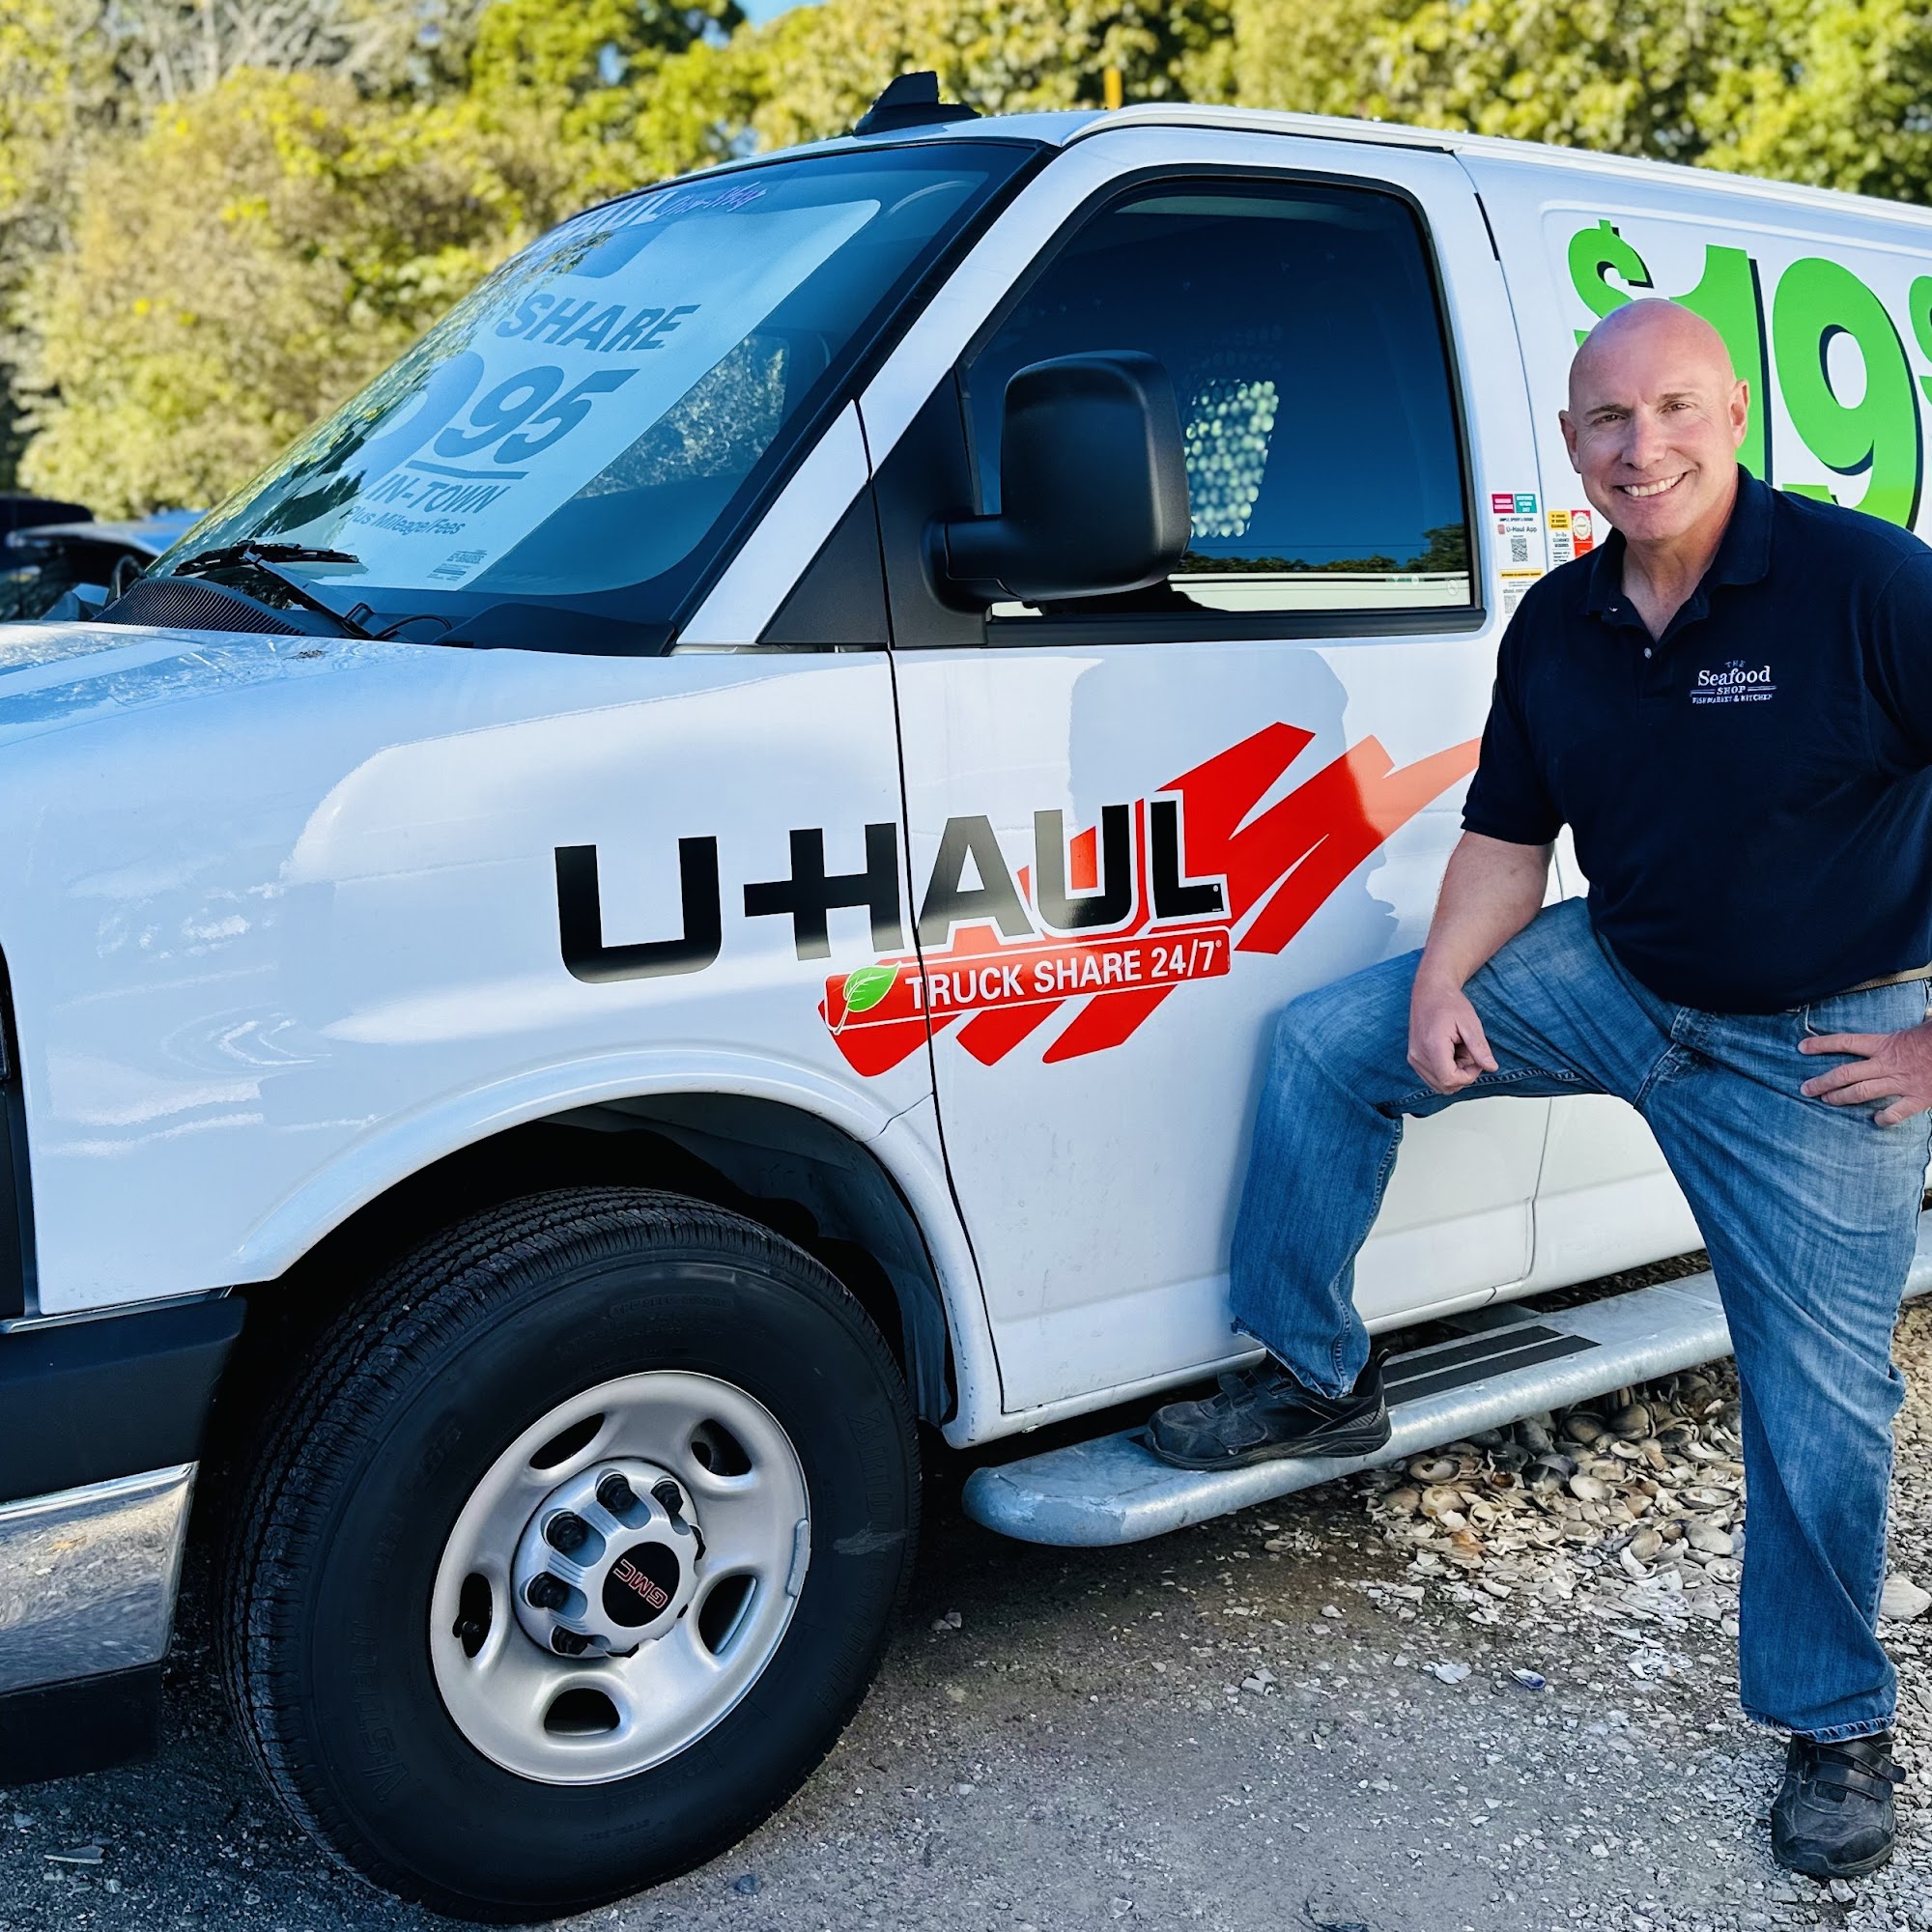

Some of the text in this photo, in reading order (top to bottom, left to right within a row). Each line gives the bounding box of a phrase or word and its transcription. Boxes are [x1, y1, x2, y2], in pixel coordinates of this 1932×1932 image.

[495, 294, 702, 353] SHARE
[365, 473, 512, 514] IN-TOWN
[350, 505, 466, 536] Plus Mileage/Fees
[1698, 665, 1772, 687] Seafood
[1724, 660, 1747, 668] THE
[1717, 685, 1747, 696] SHOP
[554, 799, 1226, 984] U-HAUL
[905, 963, 1025, 1010] TRUCK
[1034, 949, 1143, 995] SHARE
[612, 1558, 668, 1609] GMC
